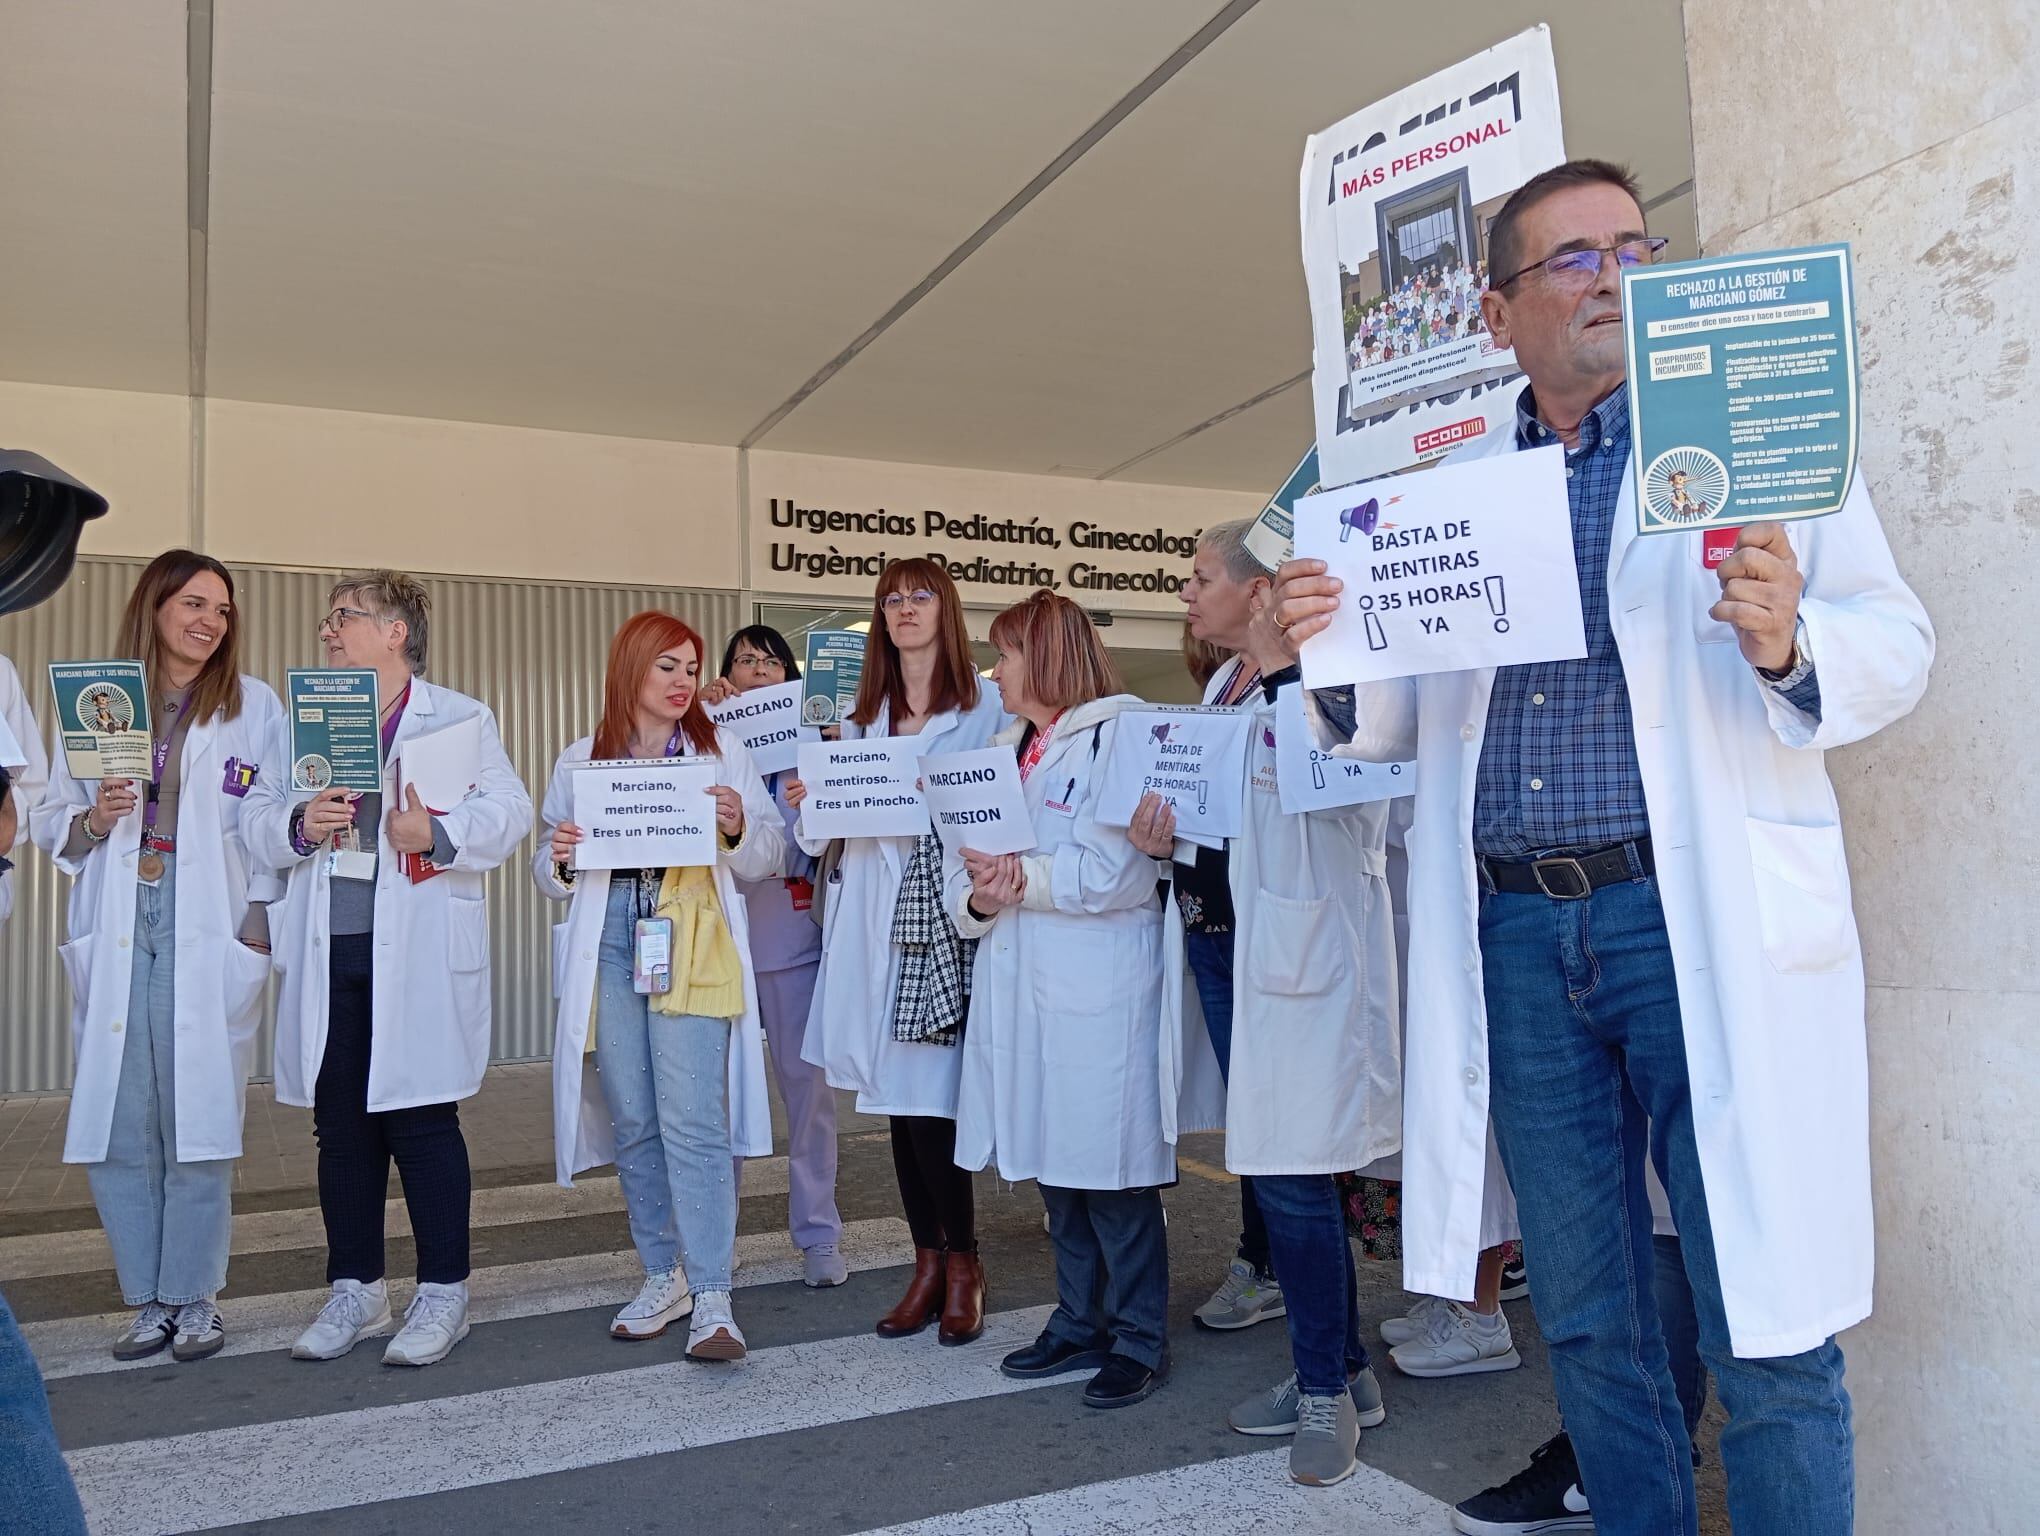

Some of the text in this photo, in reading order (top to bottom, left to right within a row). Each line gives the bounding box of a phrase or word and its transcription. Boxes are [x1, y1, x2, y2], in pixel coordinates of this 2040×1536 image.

[1342, 119, 1512, 198] MÁS PERSONAL
[1667, 268, 1807, 298] RECHAZO A LA GESTIÓN DE
[1690, 285, 1786, 310] MARCIANO GÓMEZ
[1660, 306, 1816, 333] El conseller dice una cosa y hace la contraria
[1360, 373, 1375, 386] ¡Más
[1376, 364, 1410, 379] inversión,
[1411, 359, 1426, 368] más
[1428, 342, 1476, 363] profesionales
[1655, 352, 1706, 366] COMPROMISOS
[1376, 381, 1391, 390] más
[1392, 374, 1416, 385] medios
[1418, 357, 1467, 379] diagnósticos!
[1655, 362, 1705, 375] INCUMPLIDOS:
[1435, 441, 1463, 455] valencia
[770, 498, 1203, 559] Urgencias Pediatría, Ginecologí
[1372, 520, 1471, 552] BASTA DE
[771, 543, 895, 578] Urgènci
[1068, 562, 1192, 593] Ginecolo
[1371, 550, 1480, 582] MENTIRAS
[1378, 581, 1481, 611] 35 HORAS
[1420, 616, 1450, 634] YA
[713, 697, 793, 724] MARCIANO
[743, 728, 798, 749] MISION
[830, 752, 891, 764] Marciano,
[1160, 744, 1203, 756] BASTA DE
[1155, 761, 1200, 773] MENTIRAS
[1344, 764, 1362, 776] YA
[612, 780, 676, 793] Marciano,
[824, 774, 900, 788] mentiroso...
[929, 768, 996, 787] MARCIANO
[1152, 778, 1197, 791] 35 HORAS
[1251, 776, 1279, 789] ENFE
[605, 804, 685, 815] mentiroso...
[815, 795, 919, 810] Eres un Pinocho.
[940, 807, 1001, 825] DIMISION
[592, 825, 703, 838] Eres un Pinocho.
